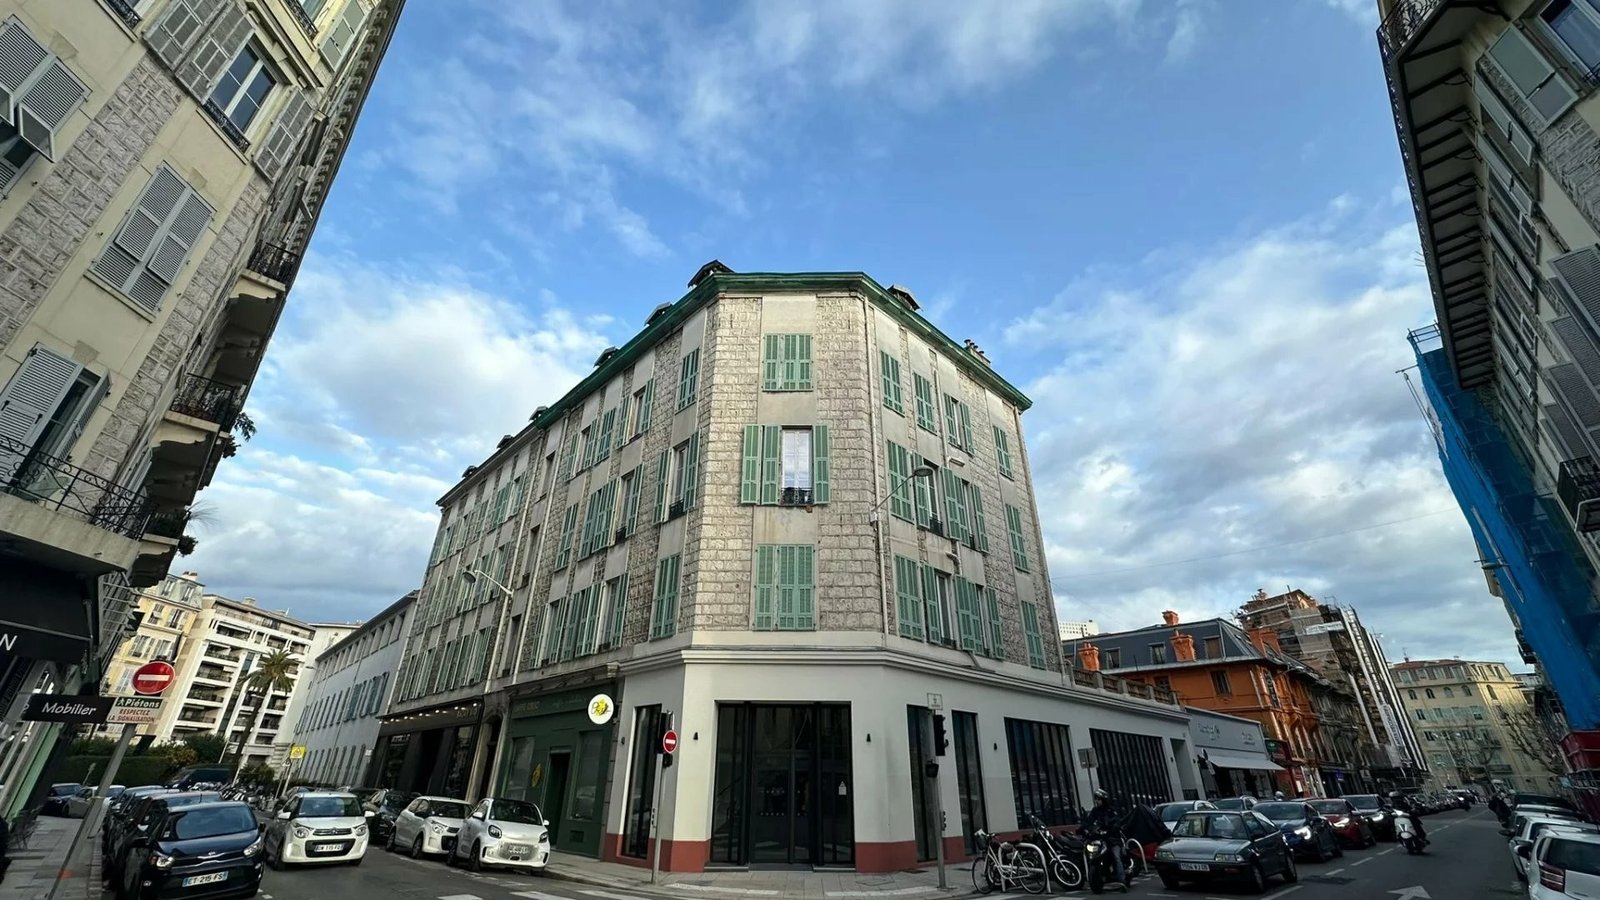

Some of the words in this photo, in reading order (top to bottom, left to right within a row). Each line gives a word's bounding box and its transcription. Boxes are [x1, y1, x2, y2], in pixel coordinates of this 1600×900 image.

[125, 697, 160, 708] Piétons
[41, 702, 97, 716] Mobilier
[119, 708, 151, 716] RESPECTEZ
